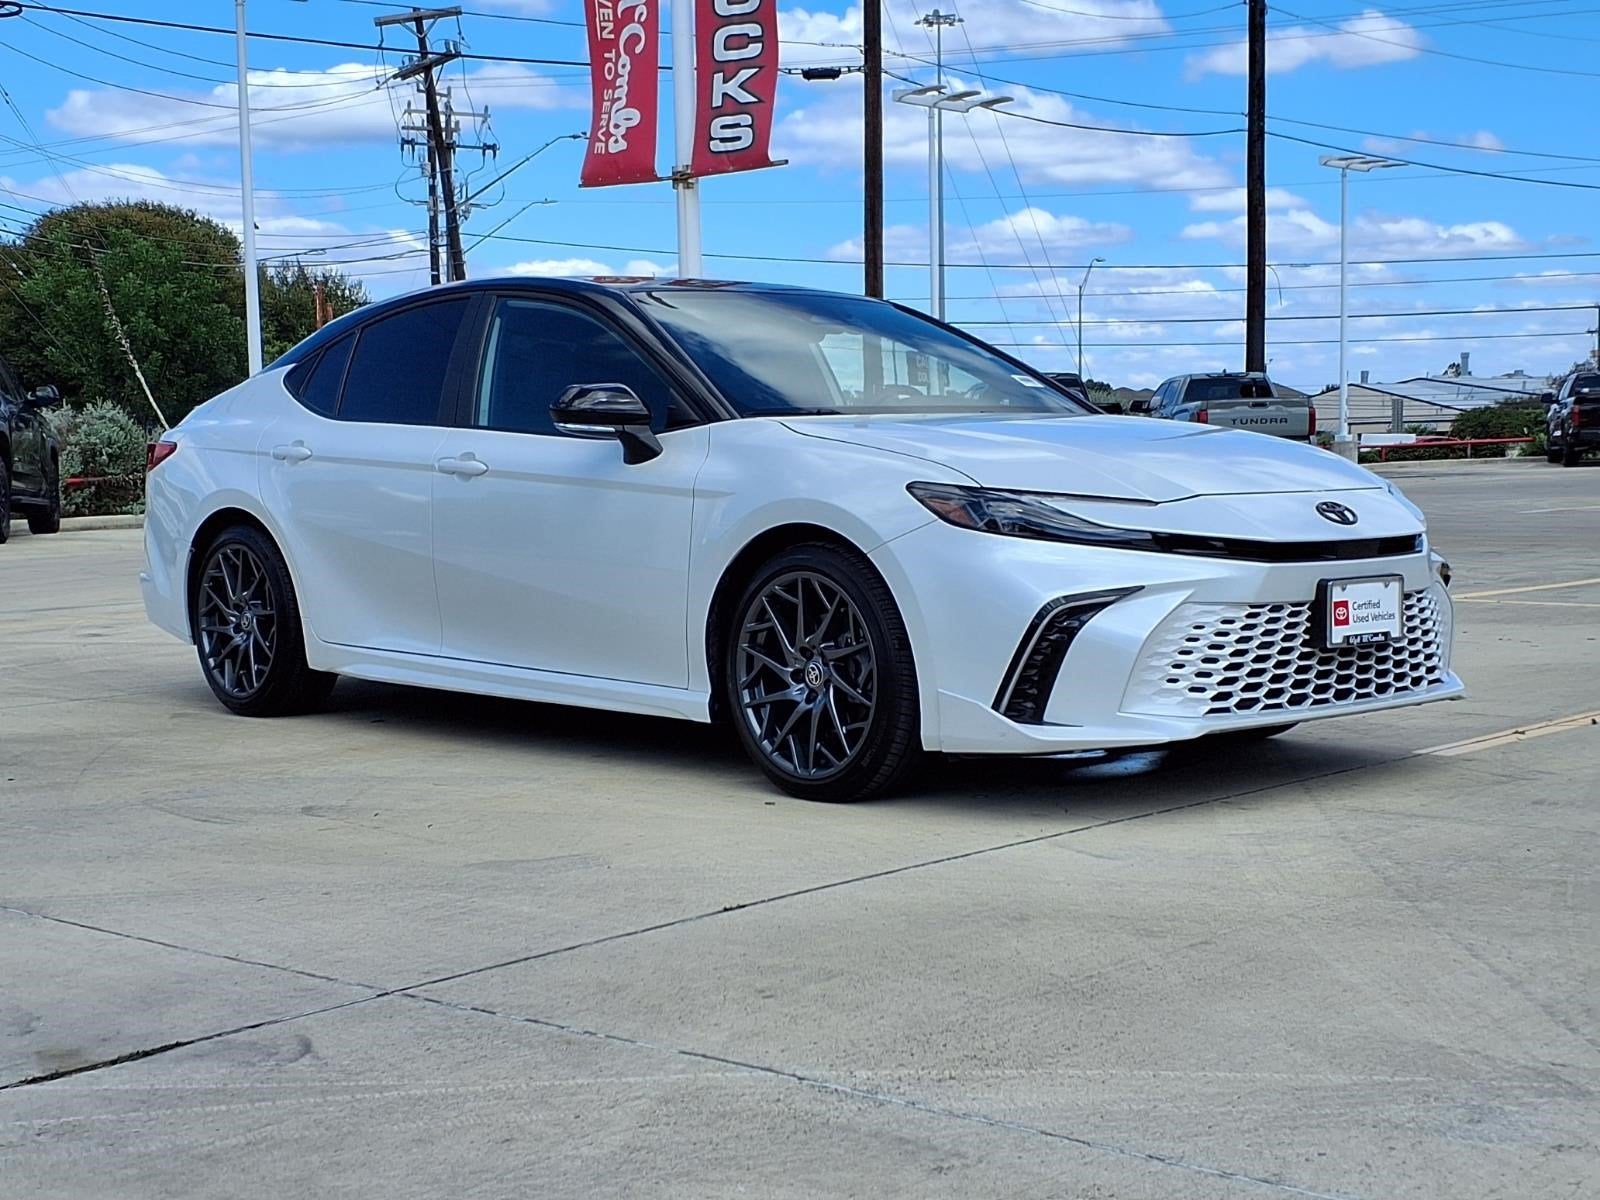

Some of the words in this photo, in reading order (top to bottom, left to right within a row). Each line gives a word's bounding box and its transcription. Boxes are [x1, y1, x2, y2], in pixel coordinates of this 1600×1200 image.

[604, 49, 616, 80] TO
[594, 89, 613, 155] SERVE
[1231, 417, 1288, 425] TUNDRA
[1352, 599, 1381, 611] Certified
[1352, 612, 1370, 623] Used
[1371, 610, 1396, 621] Vehicles
